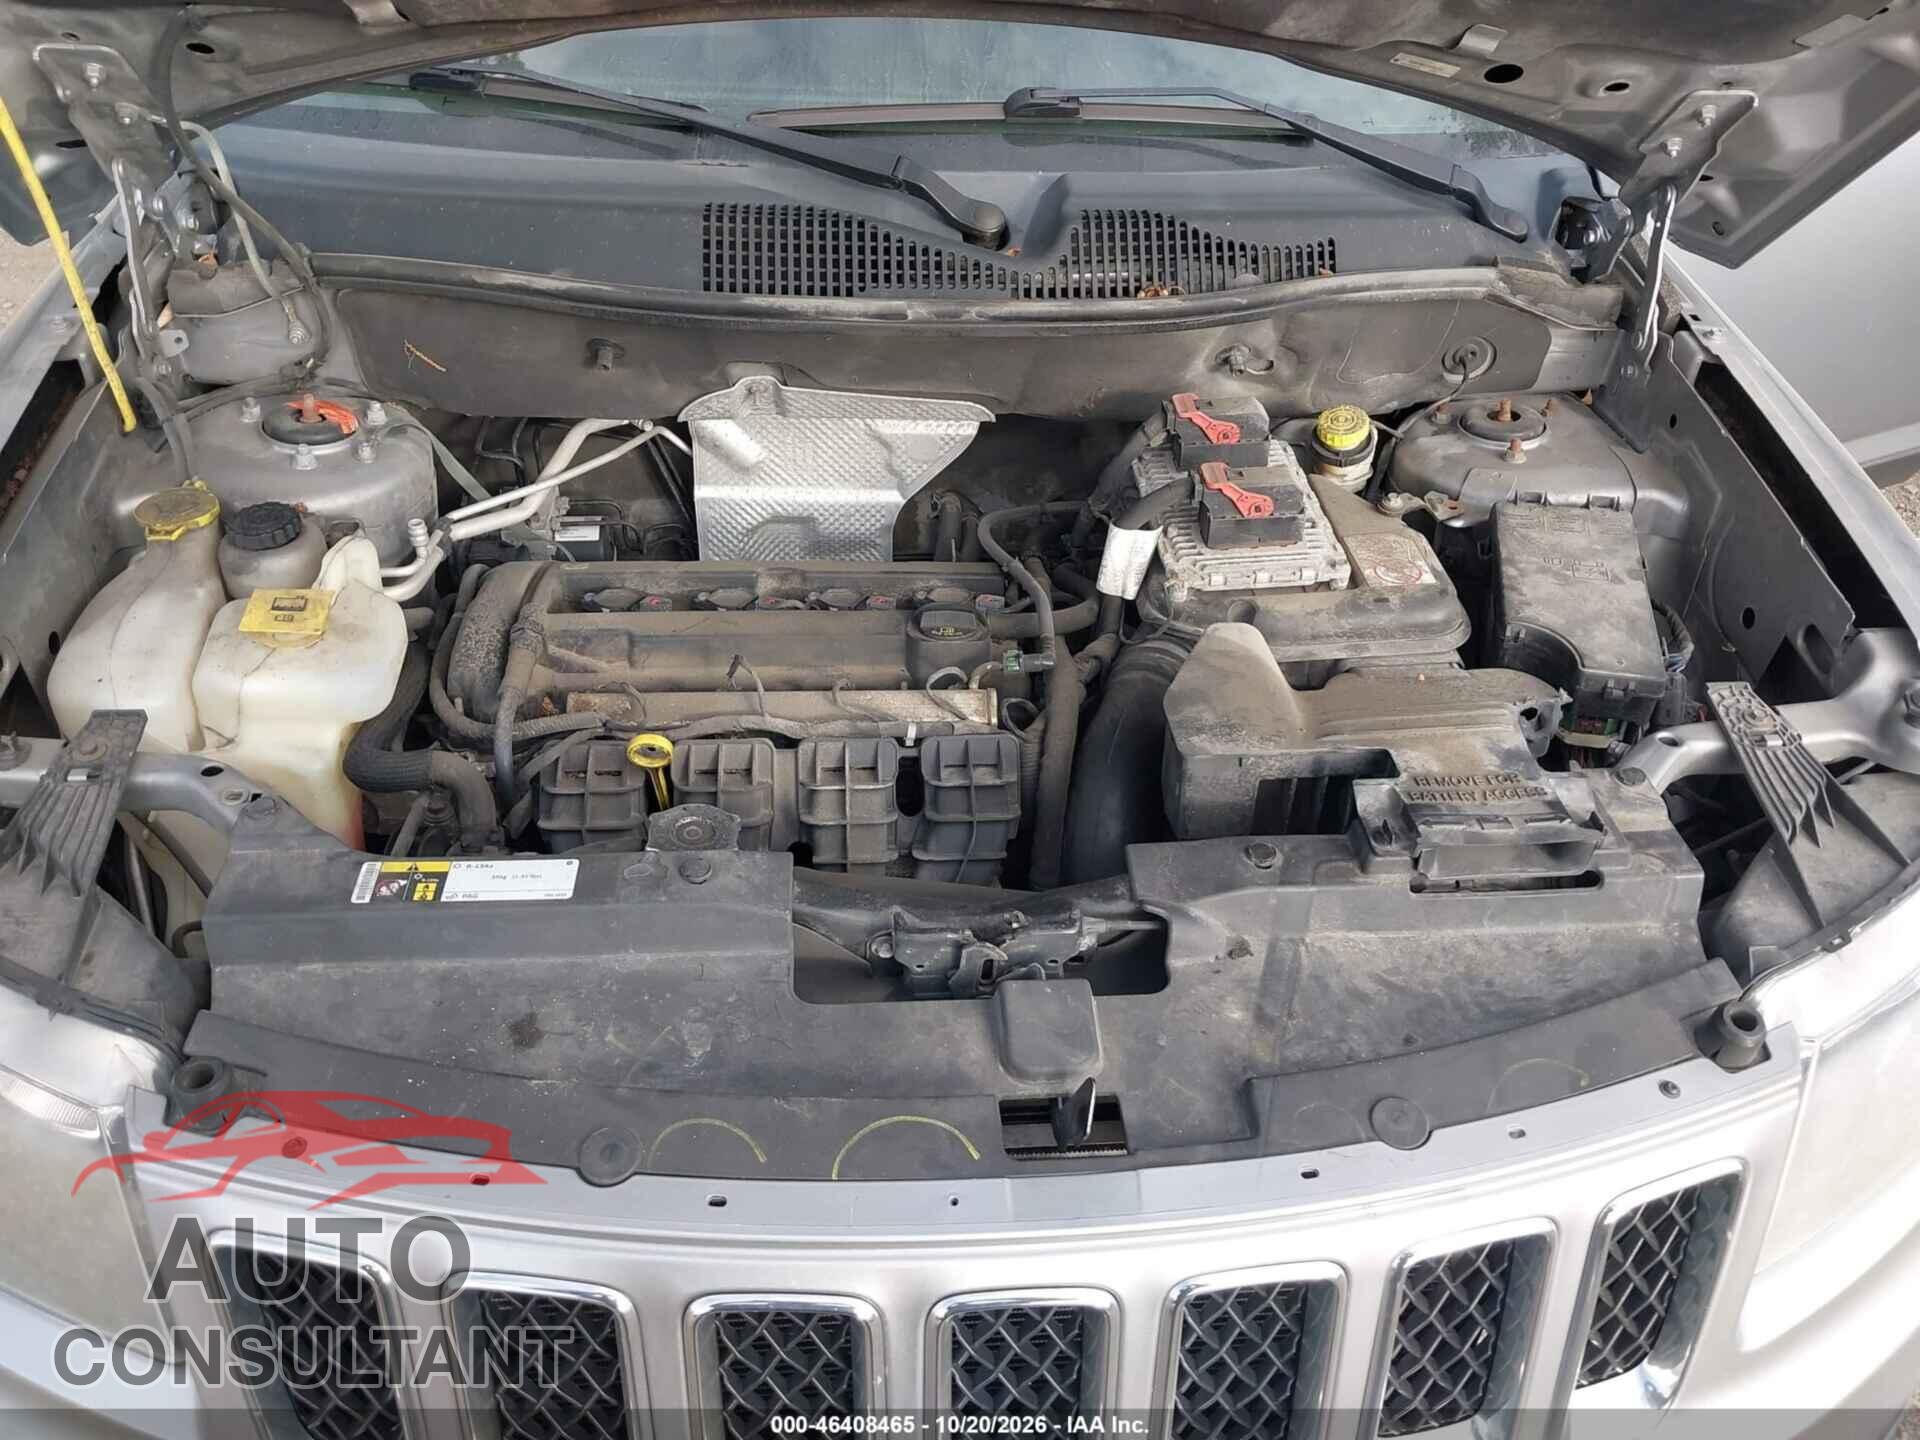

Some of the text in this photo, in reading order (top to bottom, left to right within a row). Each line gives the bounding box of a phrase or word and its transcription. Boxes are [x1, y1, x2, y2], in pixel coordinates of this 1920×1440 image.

[1413, 773, 1521, 787] REMOVE FOR
[1408, 786, 1548, 802] BATTERY ACCESS
